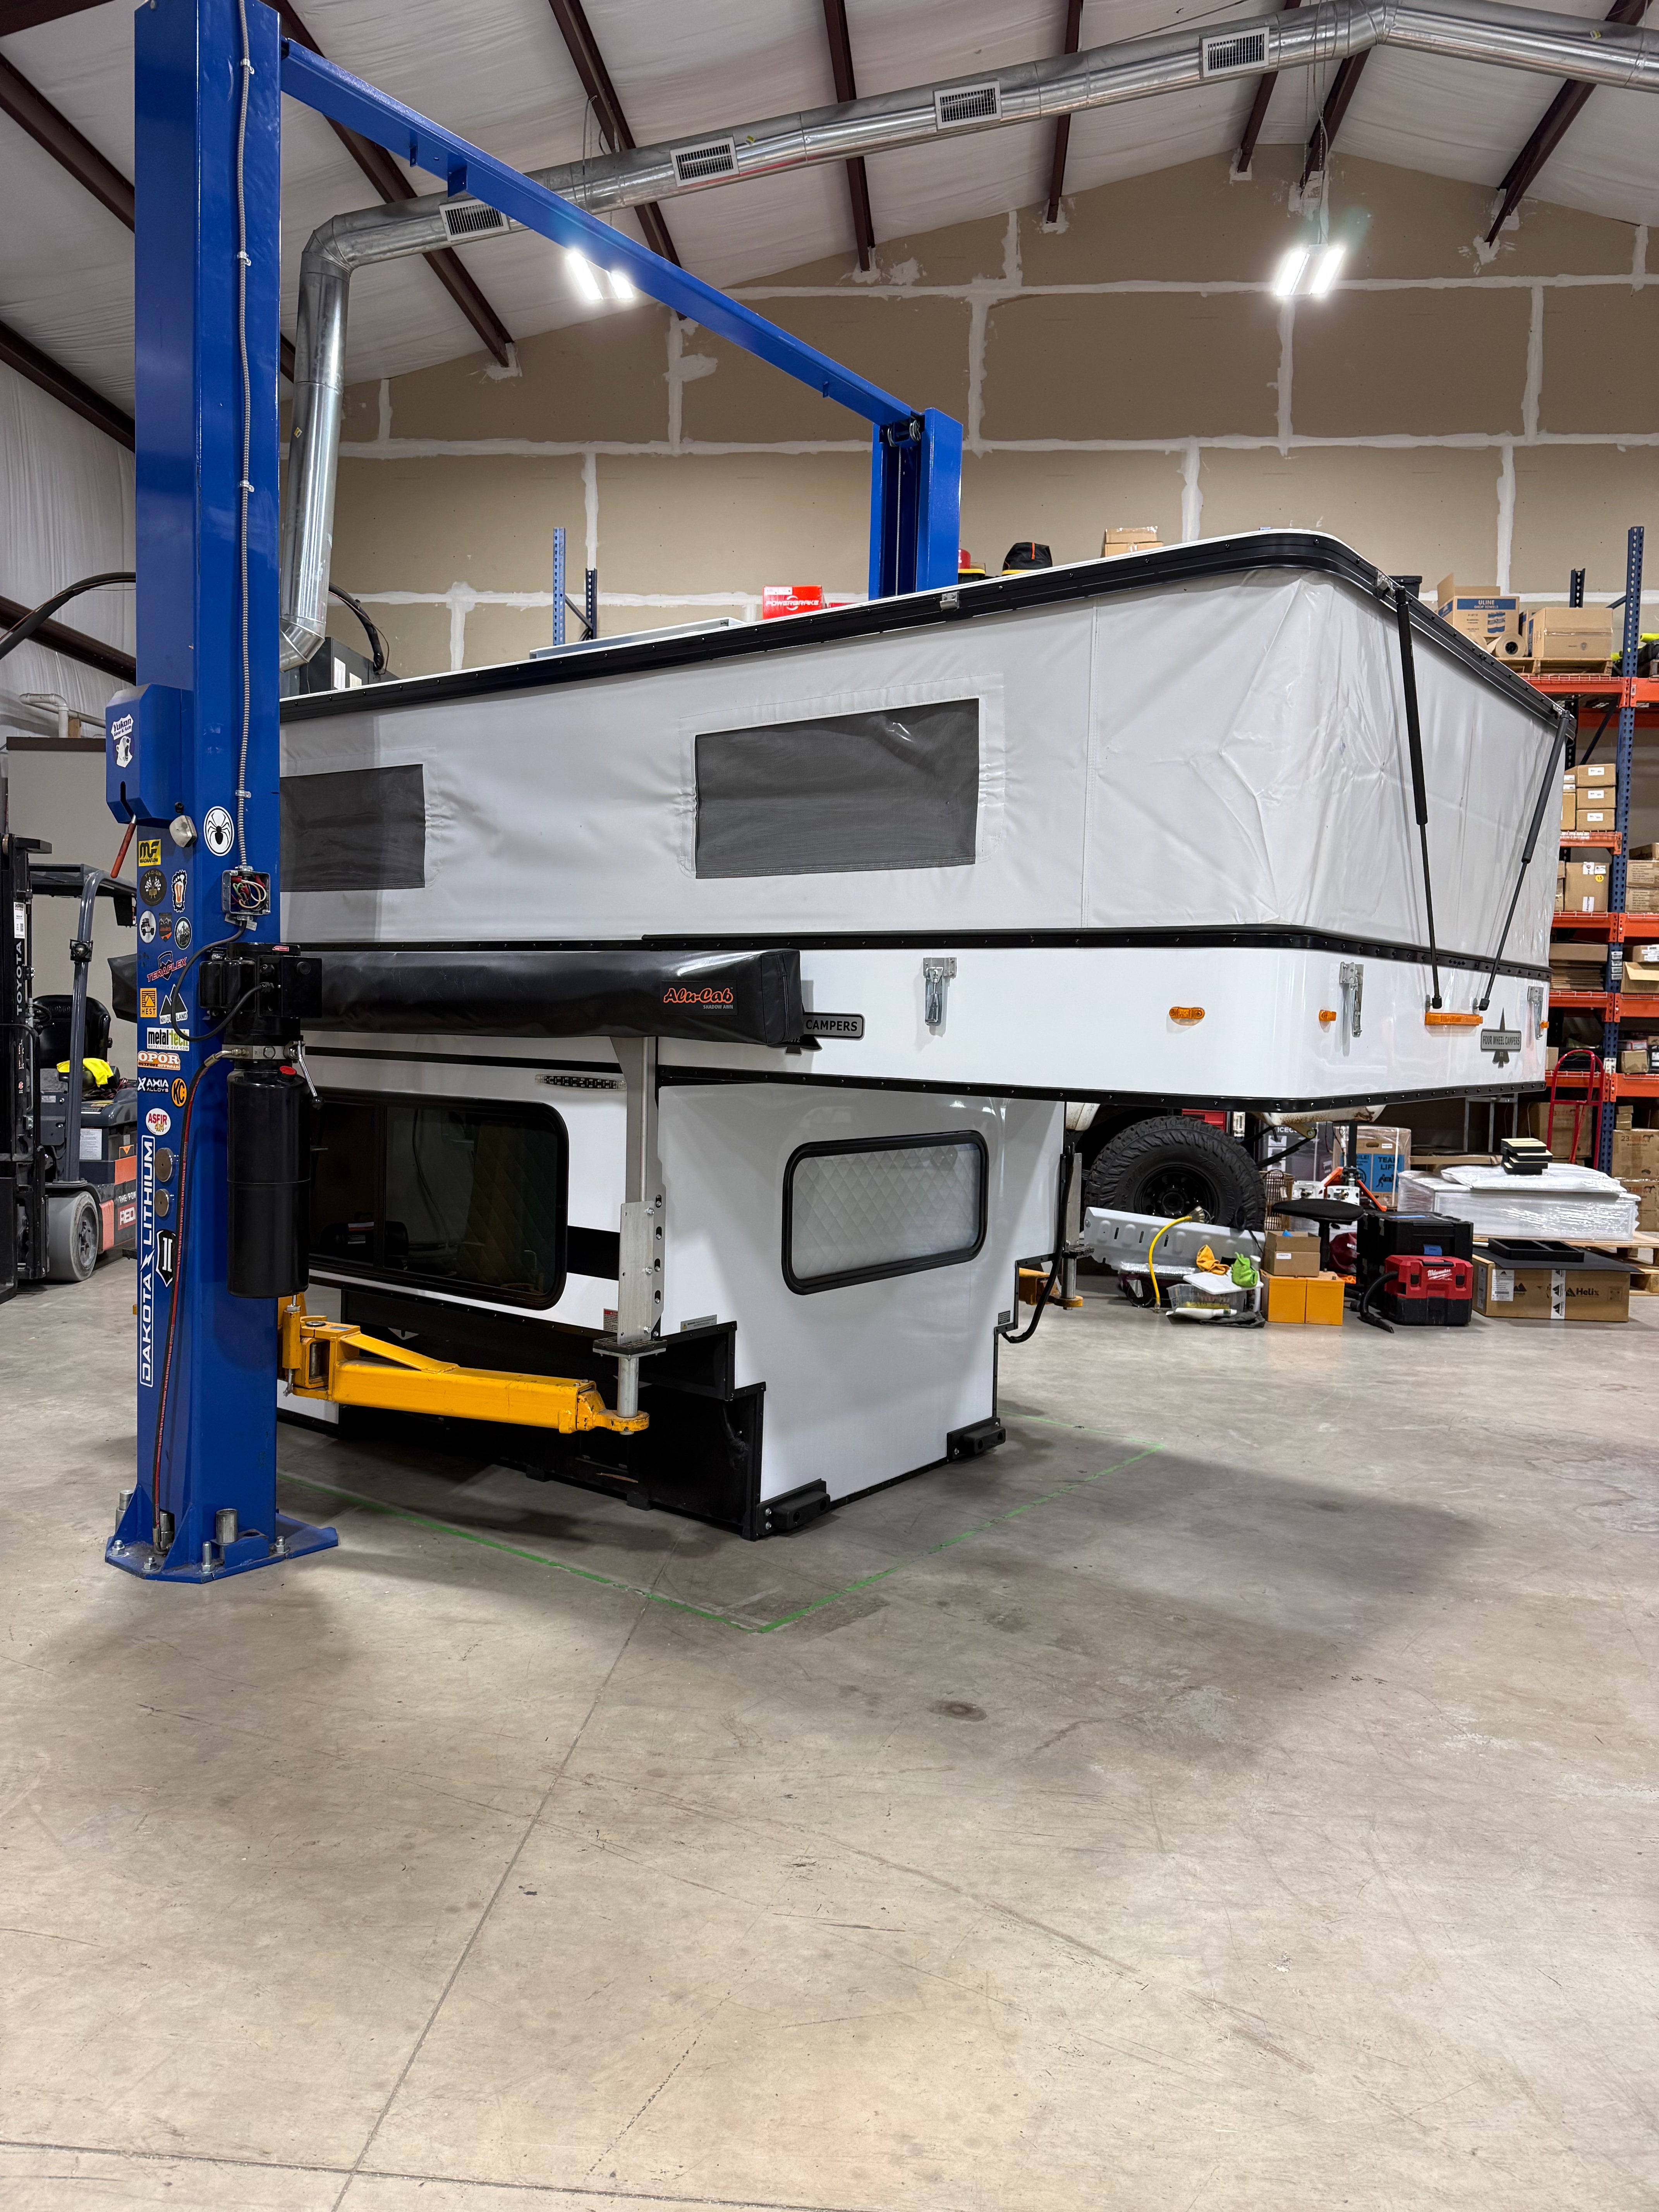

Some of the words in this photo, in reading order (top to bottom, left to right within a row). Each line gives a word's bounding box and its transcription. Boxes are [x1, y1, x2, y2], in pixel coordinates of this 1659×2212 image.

[113, 718, 131, 732] Yukon
[147, 957, 187, 982] TERAFLEX
[663, 988, 733, 1004] Alu-Cab
[167, 1013, 187, 1022] OVLAND
[805, 1020, 857, 1031] CAMPERS
[148, 1029, 169, 1045] metal
[1483, 1036, 1492, 1045] FOUR
[1493, 1036, 1504, 1045] WHEEL
[1505, 1036, 1520, 1045] CAMPERS
[138, 1051, 180, 1065] OPOR
[146, 1078, 169, 1087] AXIA
[173, 1080, 185, 1104] KC
[148, 1113, 167, 1125] ASFIR
[118, 1194, 127, 1203] THE
[144, 1141, 153, 1245] LITHIUM
[120, 1207, 136, 1226] RED
[1427, 1268, 1451, 1277] Milwaukee
[1576, 1288, 1599, 1296] Helix
[143, 1273, 151, 1381] DAKOTA
